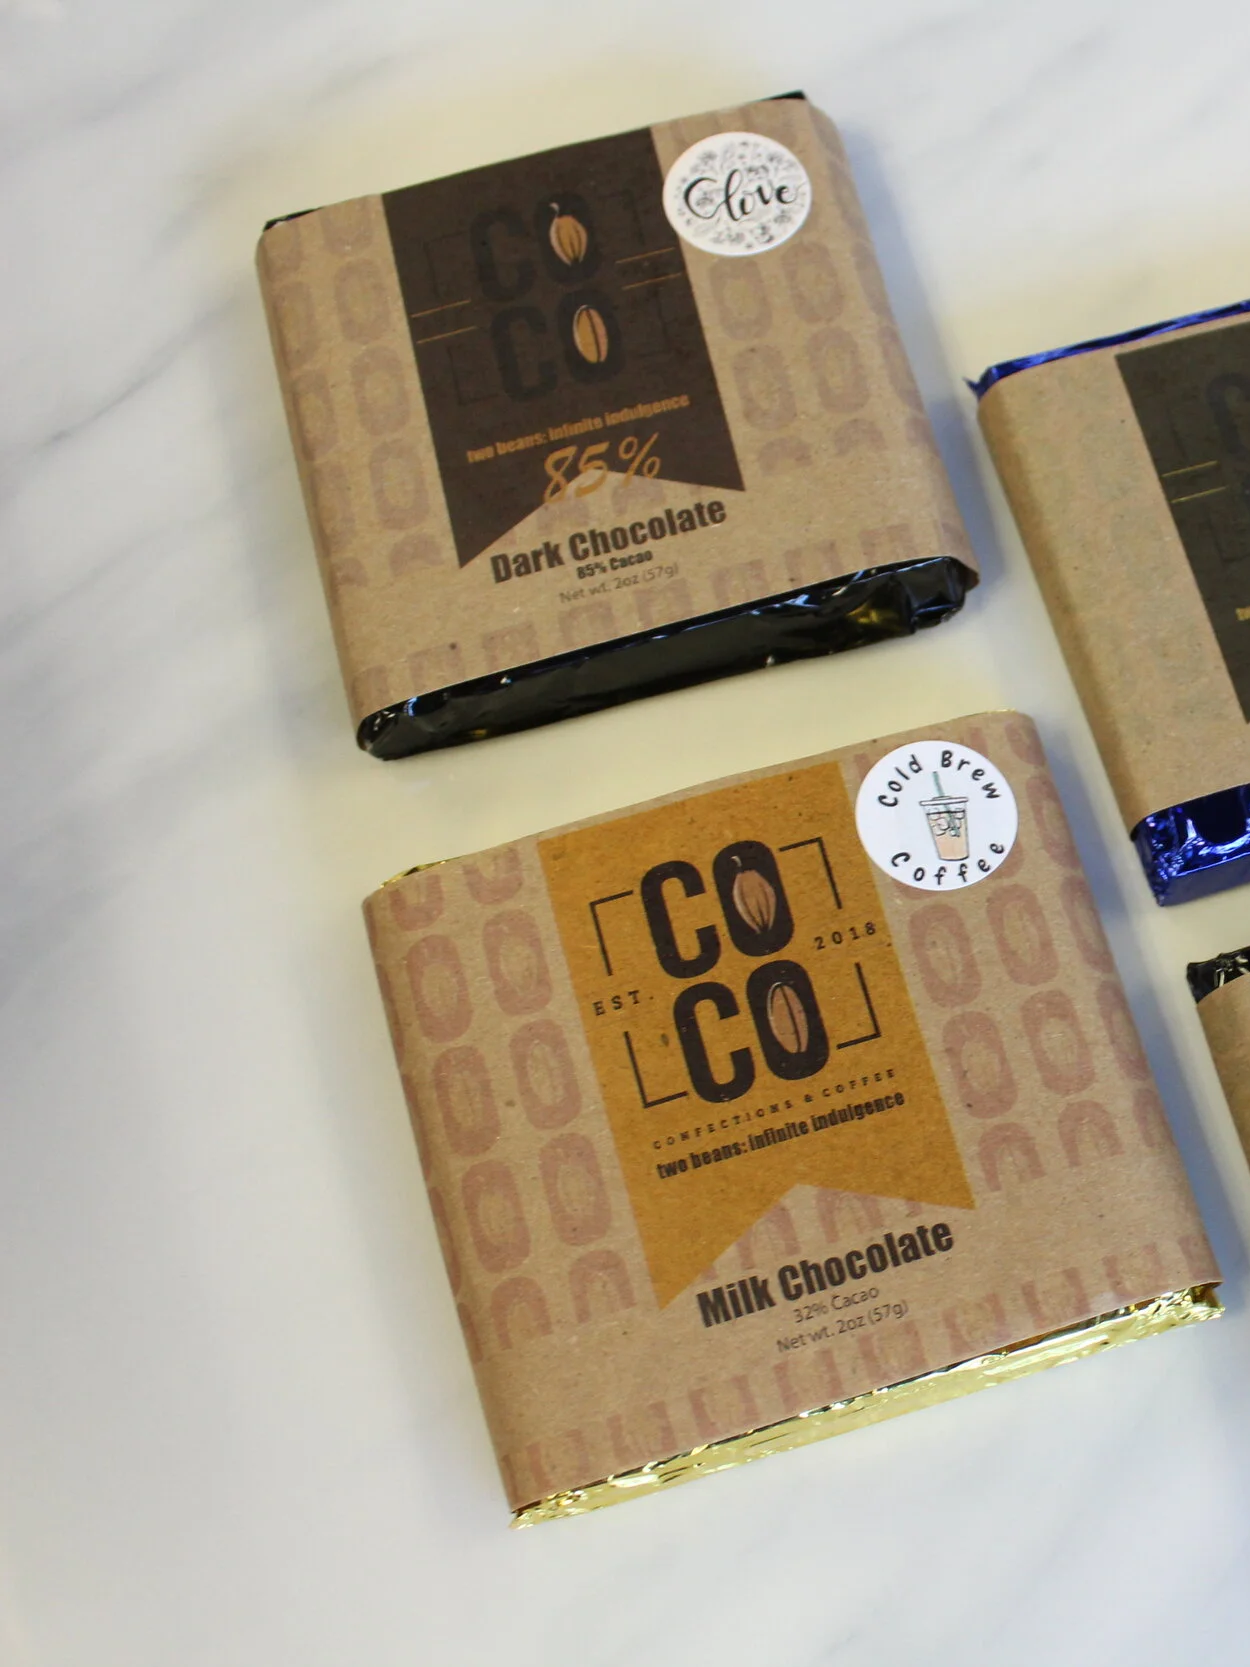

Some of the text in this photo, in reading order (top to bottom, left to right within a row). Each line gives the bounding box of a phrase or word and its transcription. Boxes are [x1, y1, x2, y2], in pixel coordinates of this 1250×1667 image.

[683, 168, 800, 222] Clove
[470, 191, 601, 301] CO
[491, 287, 626, 399] CO
[604, 394, 691, 426] indulgence
[543, 431, 662, 504] 85%
[490, 500, 728, 584] Dark Chocolate
[577, 550, 653, 580] 85% Cacao
[559, 589, 585, 604] Net
[614, 575, 640, 591] 2oz
[643, 563, 679, 583] (57g)
[877, 749, 1001, 808] Cold Brew
[890, 842, 1005, 886] Coffee
[640, 839, 796, 980] CO
[814, 920, 878, 951] 2018
[591, 989, 654, 1017] EST.
[672, 959, 831, 1105] CO
[652, 1067, 897, 1151] CONFECTIONS & COFFEE
[656, 1090, 906, 1181] two beans: infinite indulgence
[696, 1221, 955, 1329] Milk Chocolate
[776, 1299, 909, 1354] Net wt. 2oz (57g)
[793, 1285, 880, 1325] 32% Cacao
